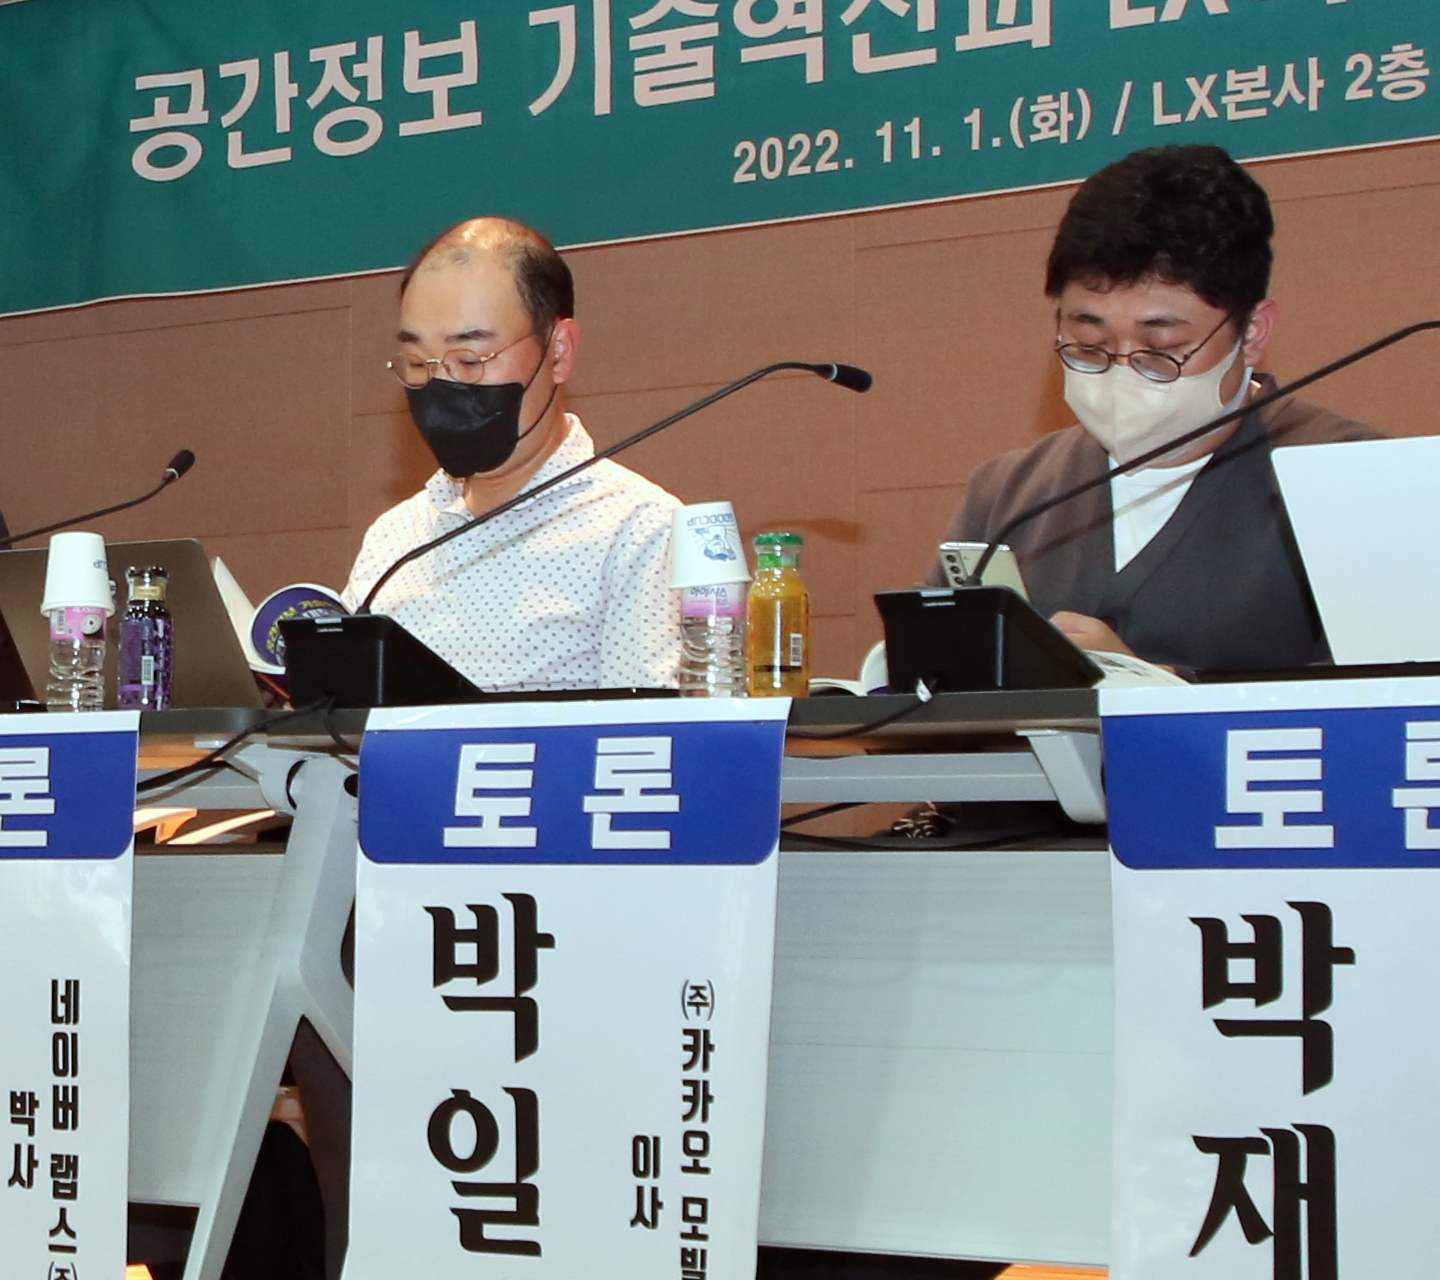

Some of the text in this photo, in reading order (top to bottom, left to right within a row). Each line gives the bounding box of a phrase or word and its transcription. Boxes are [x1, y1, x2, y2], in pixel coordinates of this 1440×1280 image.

[130, 21, 481, 181] 공간정보
[734, 130, 853, 183] 2022.
[876, 117, 940, 162] 11.
[964, 88, 1090, 150] 1.(화)
[1153, 57, 1324, 125] LX본사
[1345, 44, 1429, 100] 2층
[51, 979, 79, 1130] 네이버
[8, 1091, 39, 1189] 박사
[630, 1135, 663, 1229] 이사
